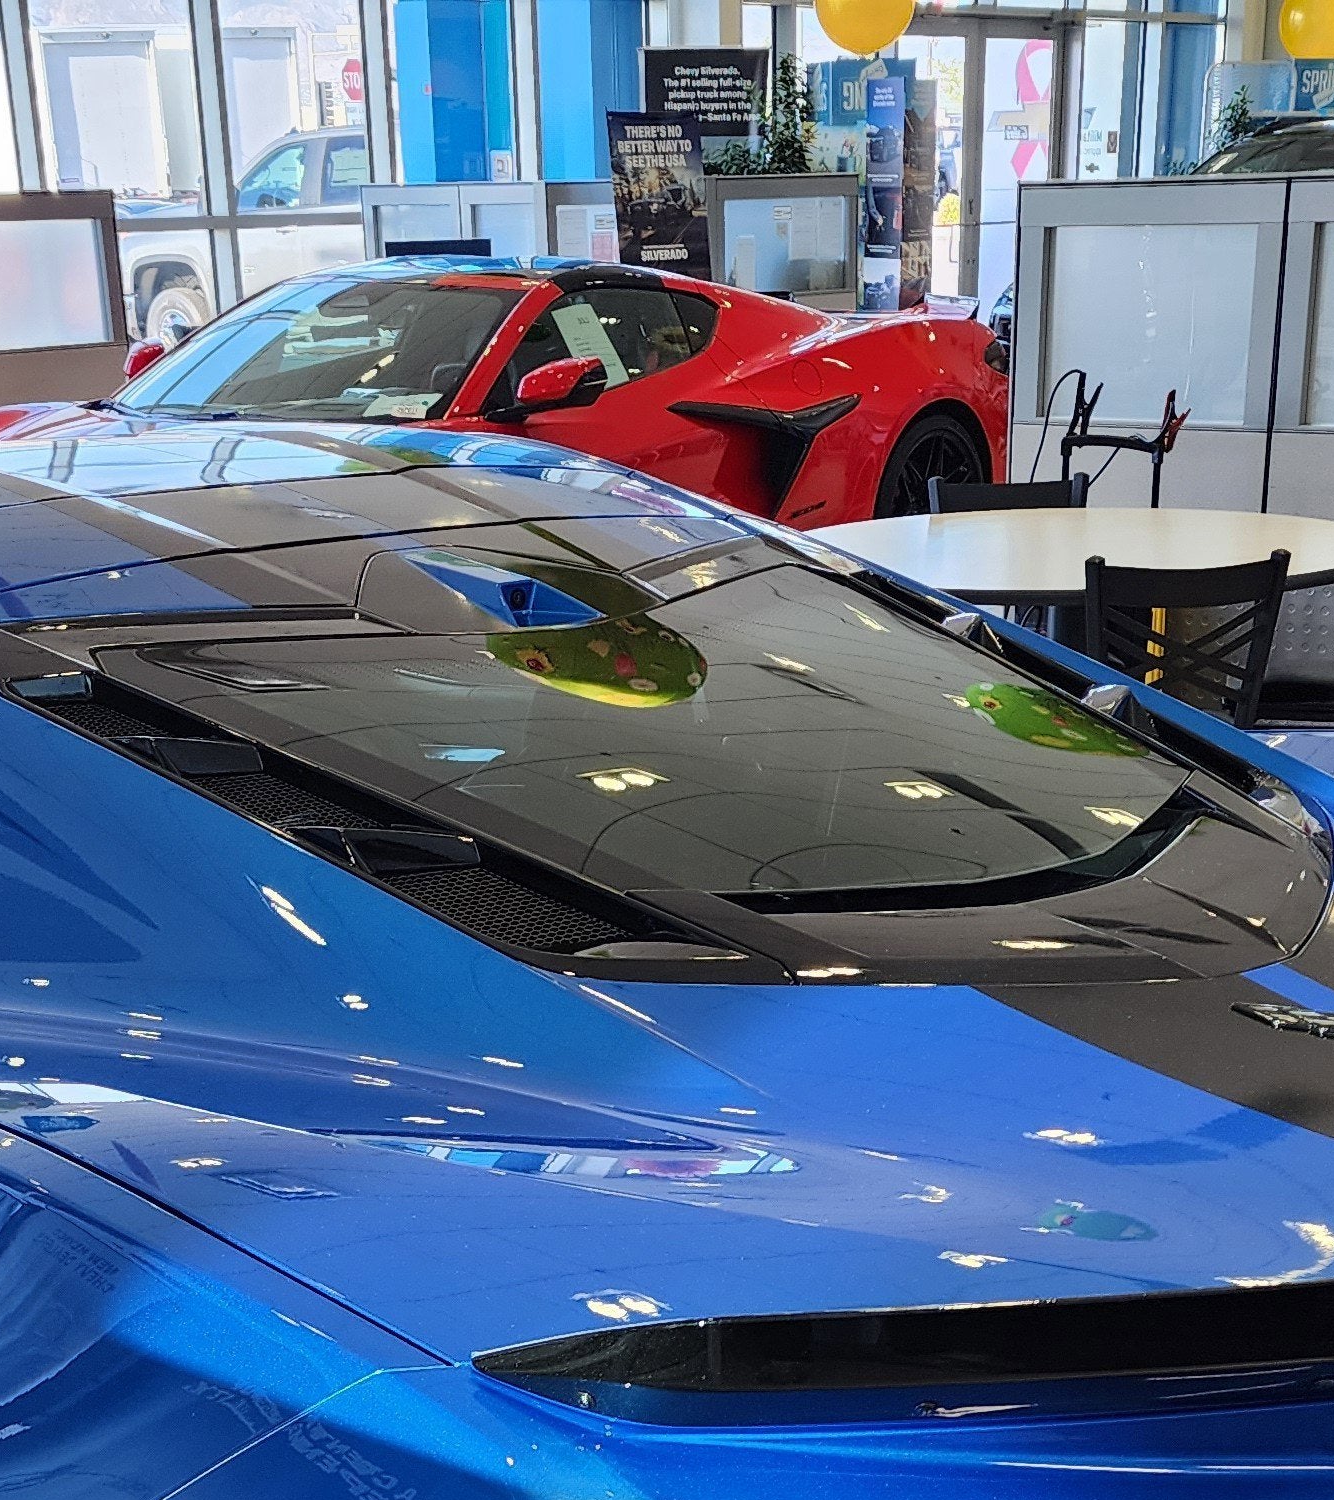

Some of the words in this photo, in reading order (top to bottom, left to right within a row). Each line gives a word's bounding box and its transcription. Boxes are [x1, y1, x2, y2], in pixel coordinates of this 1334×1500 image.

[674, 66, 700, 77] Chevy
[700, 66, 741, 76] Silverado.
[343, 72, 361, 90] STO
[663, 78, 679, 87] The
[691, 78, 719, 89] selling
[668, 89, 696, 100] pickup
[697, 89, 719, 98] truck
[719, 90, 748, 100] among
[664, 101, 699, 112] Hispanic
[700, 101, 728, 111] buyers
[728, 101, 737, 110] in
[737, 101, 752, 110] the
[732, 113, 742, 121] Fe
[624, 126, 667, 138] THERE'S
[667, 126, 683, 138] NO
[618, 140, 656, 153] BETTER
[656, 140, 678, 153] WAY
[678, 139, 692, 152] TO
[625, 155, 645, 168] SEE
[645, 155, 665, 168] THE
[666, 155, 687, 167] USA
[641, 248, 689, 261] SILVERADO
